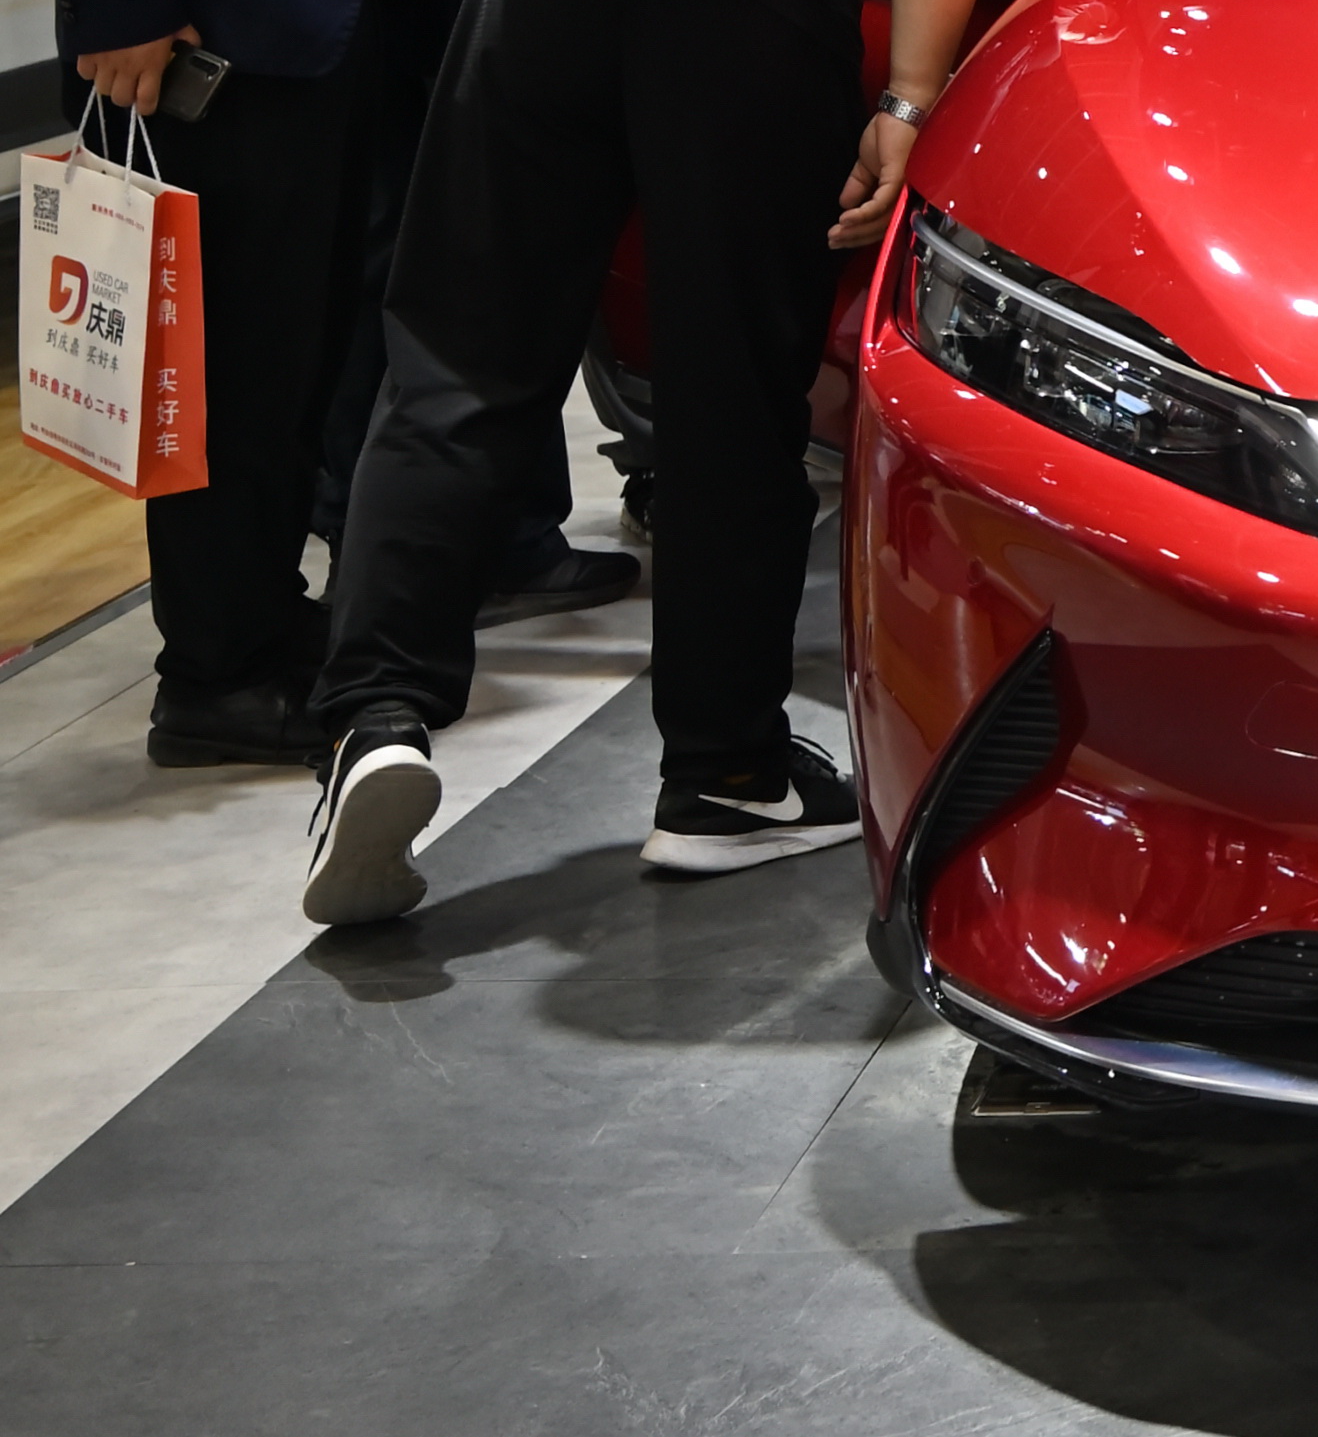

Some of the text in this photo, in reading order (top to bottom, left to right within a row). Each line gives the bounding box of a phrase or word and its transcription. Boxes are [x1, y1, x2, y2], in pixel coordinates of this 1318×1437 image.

[91, 283, 122, 305] MARKET
[92, 270, 129, 294] USED CAR
[85, 300, 126, 347] 庆鼎
[45, 328, 120, 374] 到庆鼎 买好车
[29, 367, 130, 425] 到庆鼎买放心二手车
[155, 368, 180, 458] 买好车
